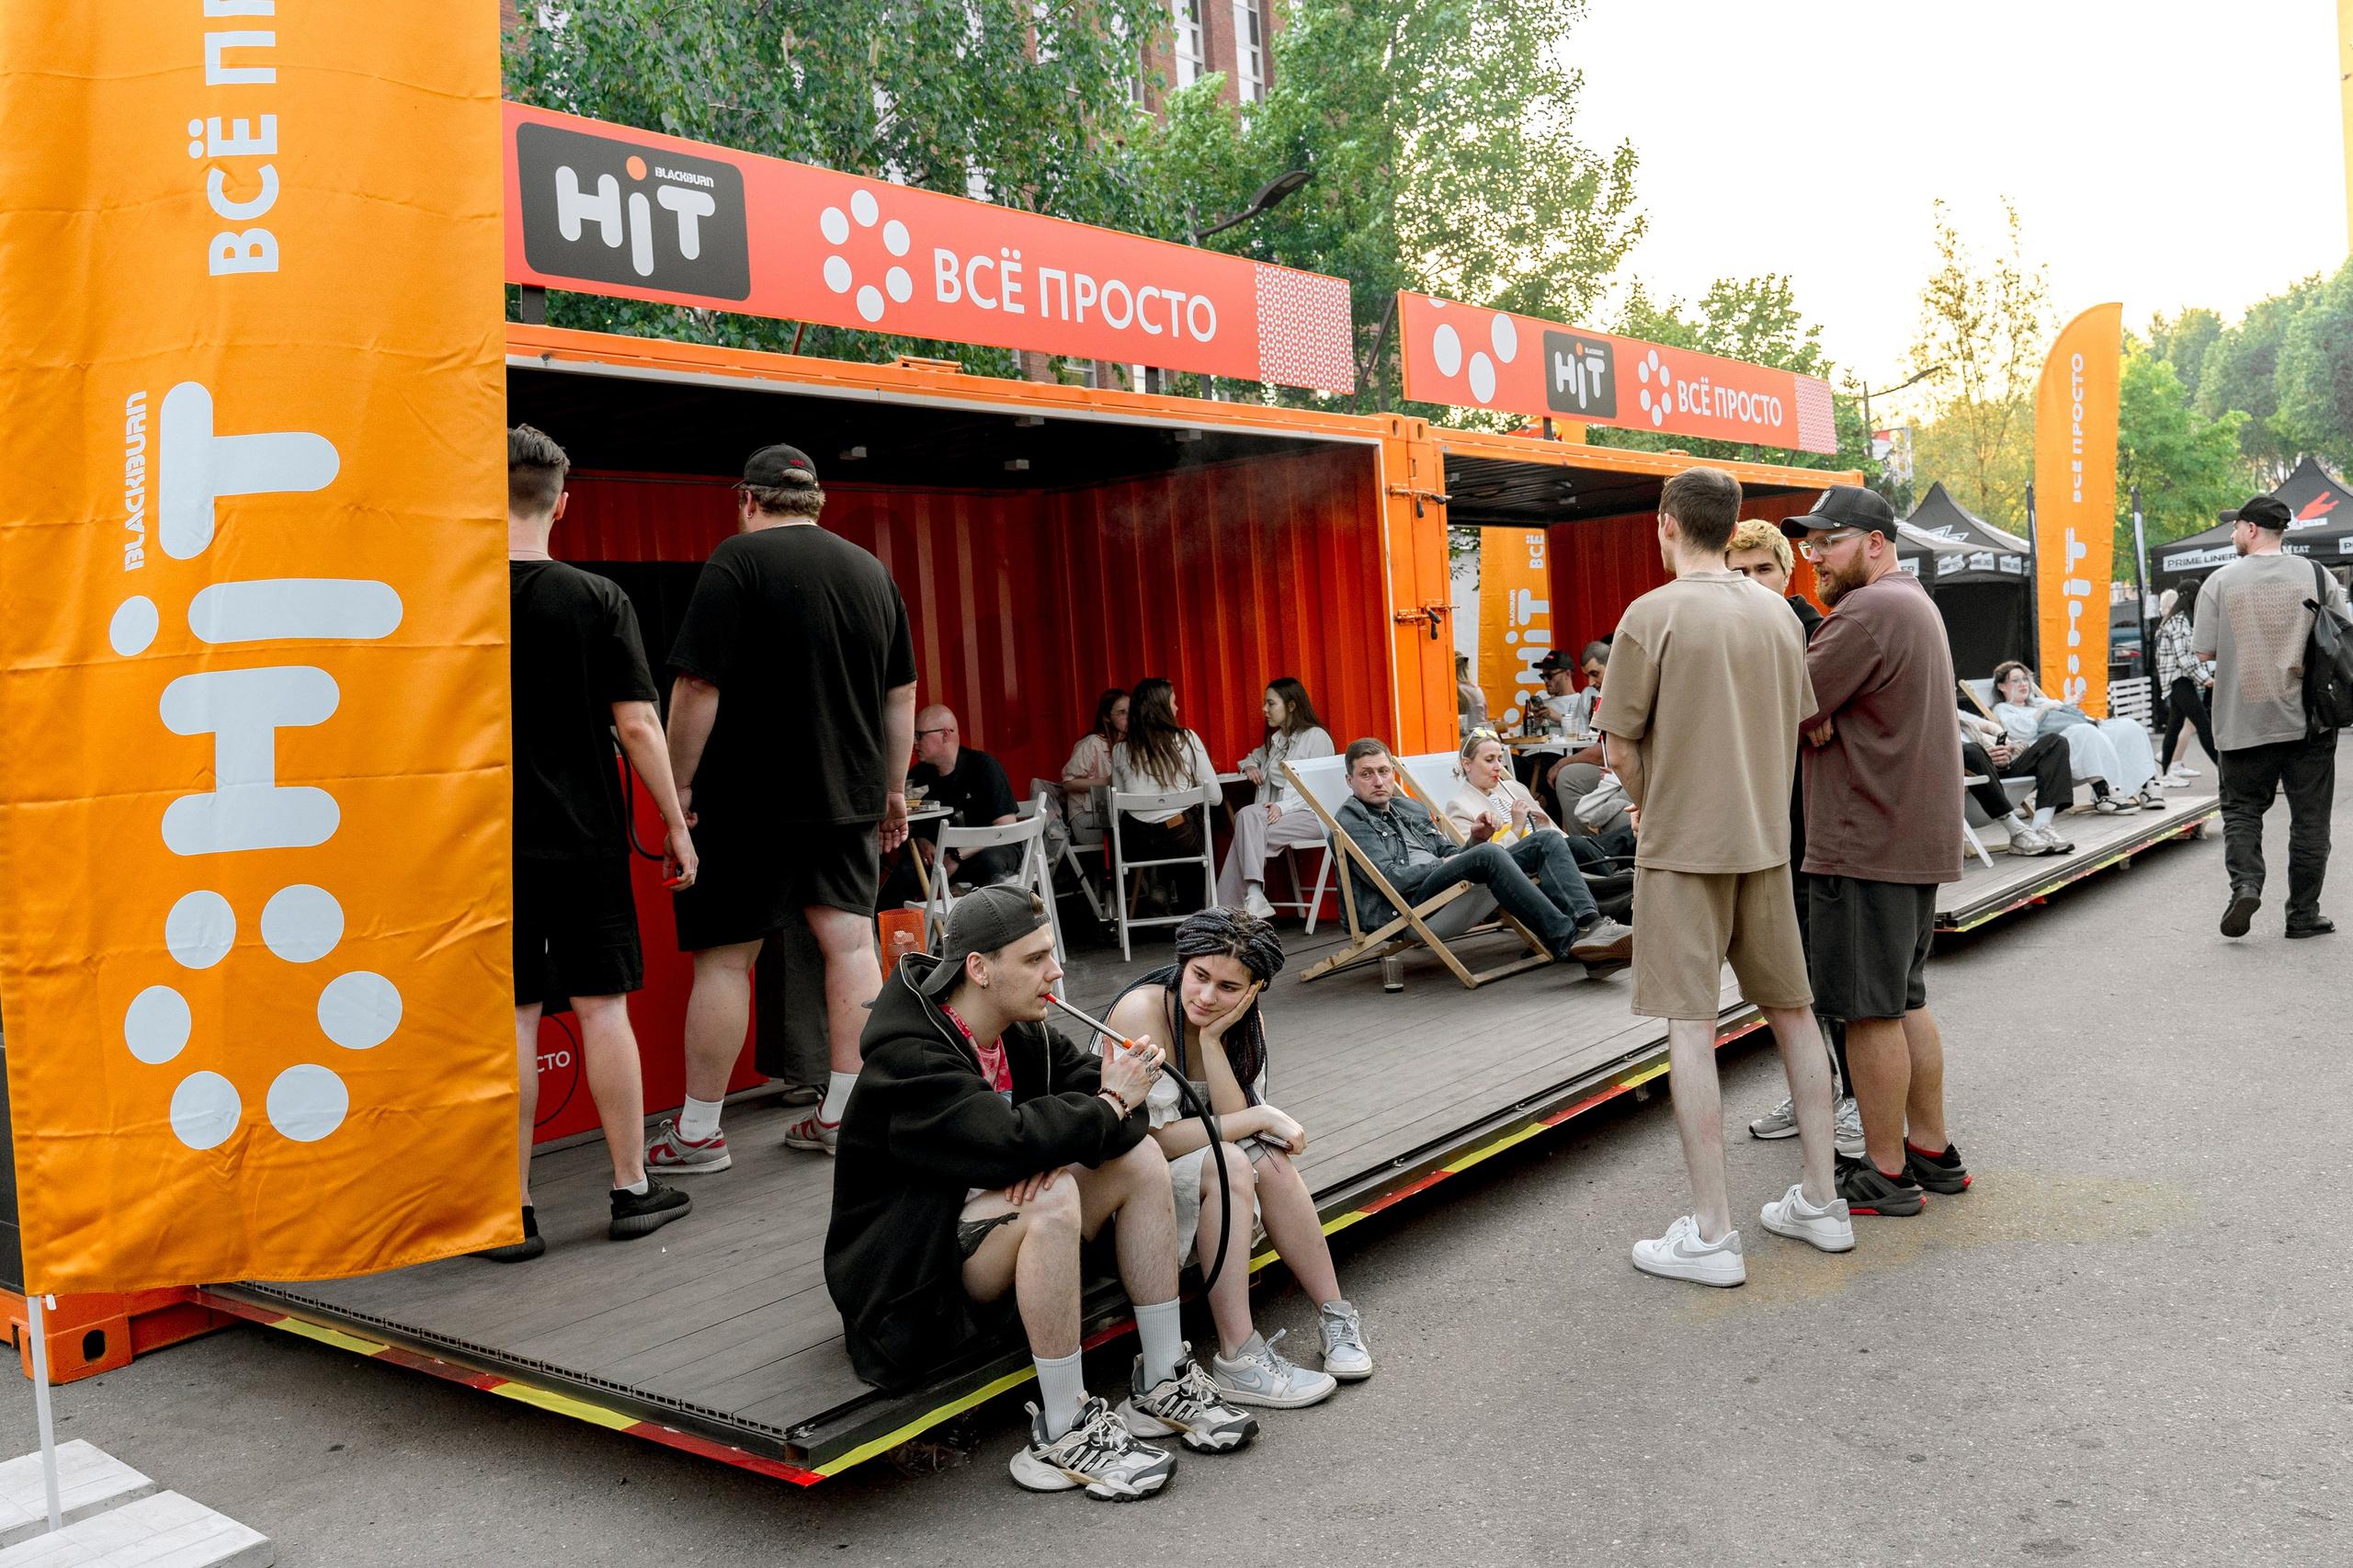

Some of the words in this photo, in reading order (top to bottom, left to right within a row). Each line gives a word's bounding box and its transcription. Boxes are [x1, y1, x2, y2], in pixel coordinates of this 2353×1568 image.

[188, 113, 279, 276] ВСЁ
[654, 165, 715, 188] BLACKBURN
[933, 246, 1026, 315] ВСЁ
[1038, 266, 1218, 343] ПРОСТО
[1677, 376, 1712, 416] ВСЁ
[1713, 386, 1783, 427] ПРОСТО
[2071, 352, 2085, 455] ПРОСТО
[123, 389, 148, 573] BLACKBURN
[1525, 534, 1545, 569] ВСЁ
[2167, 556, 2202, 568] PRIME
[2204, 552, 2237, 563] LINER
[536, 1050, 571, 1074] СТО
